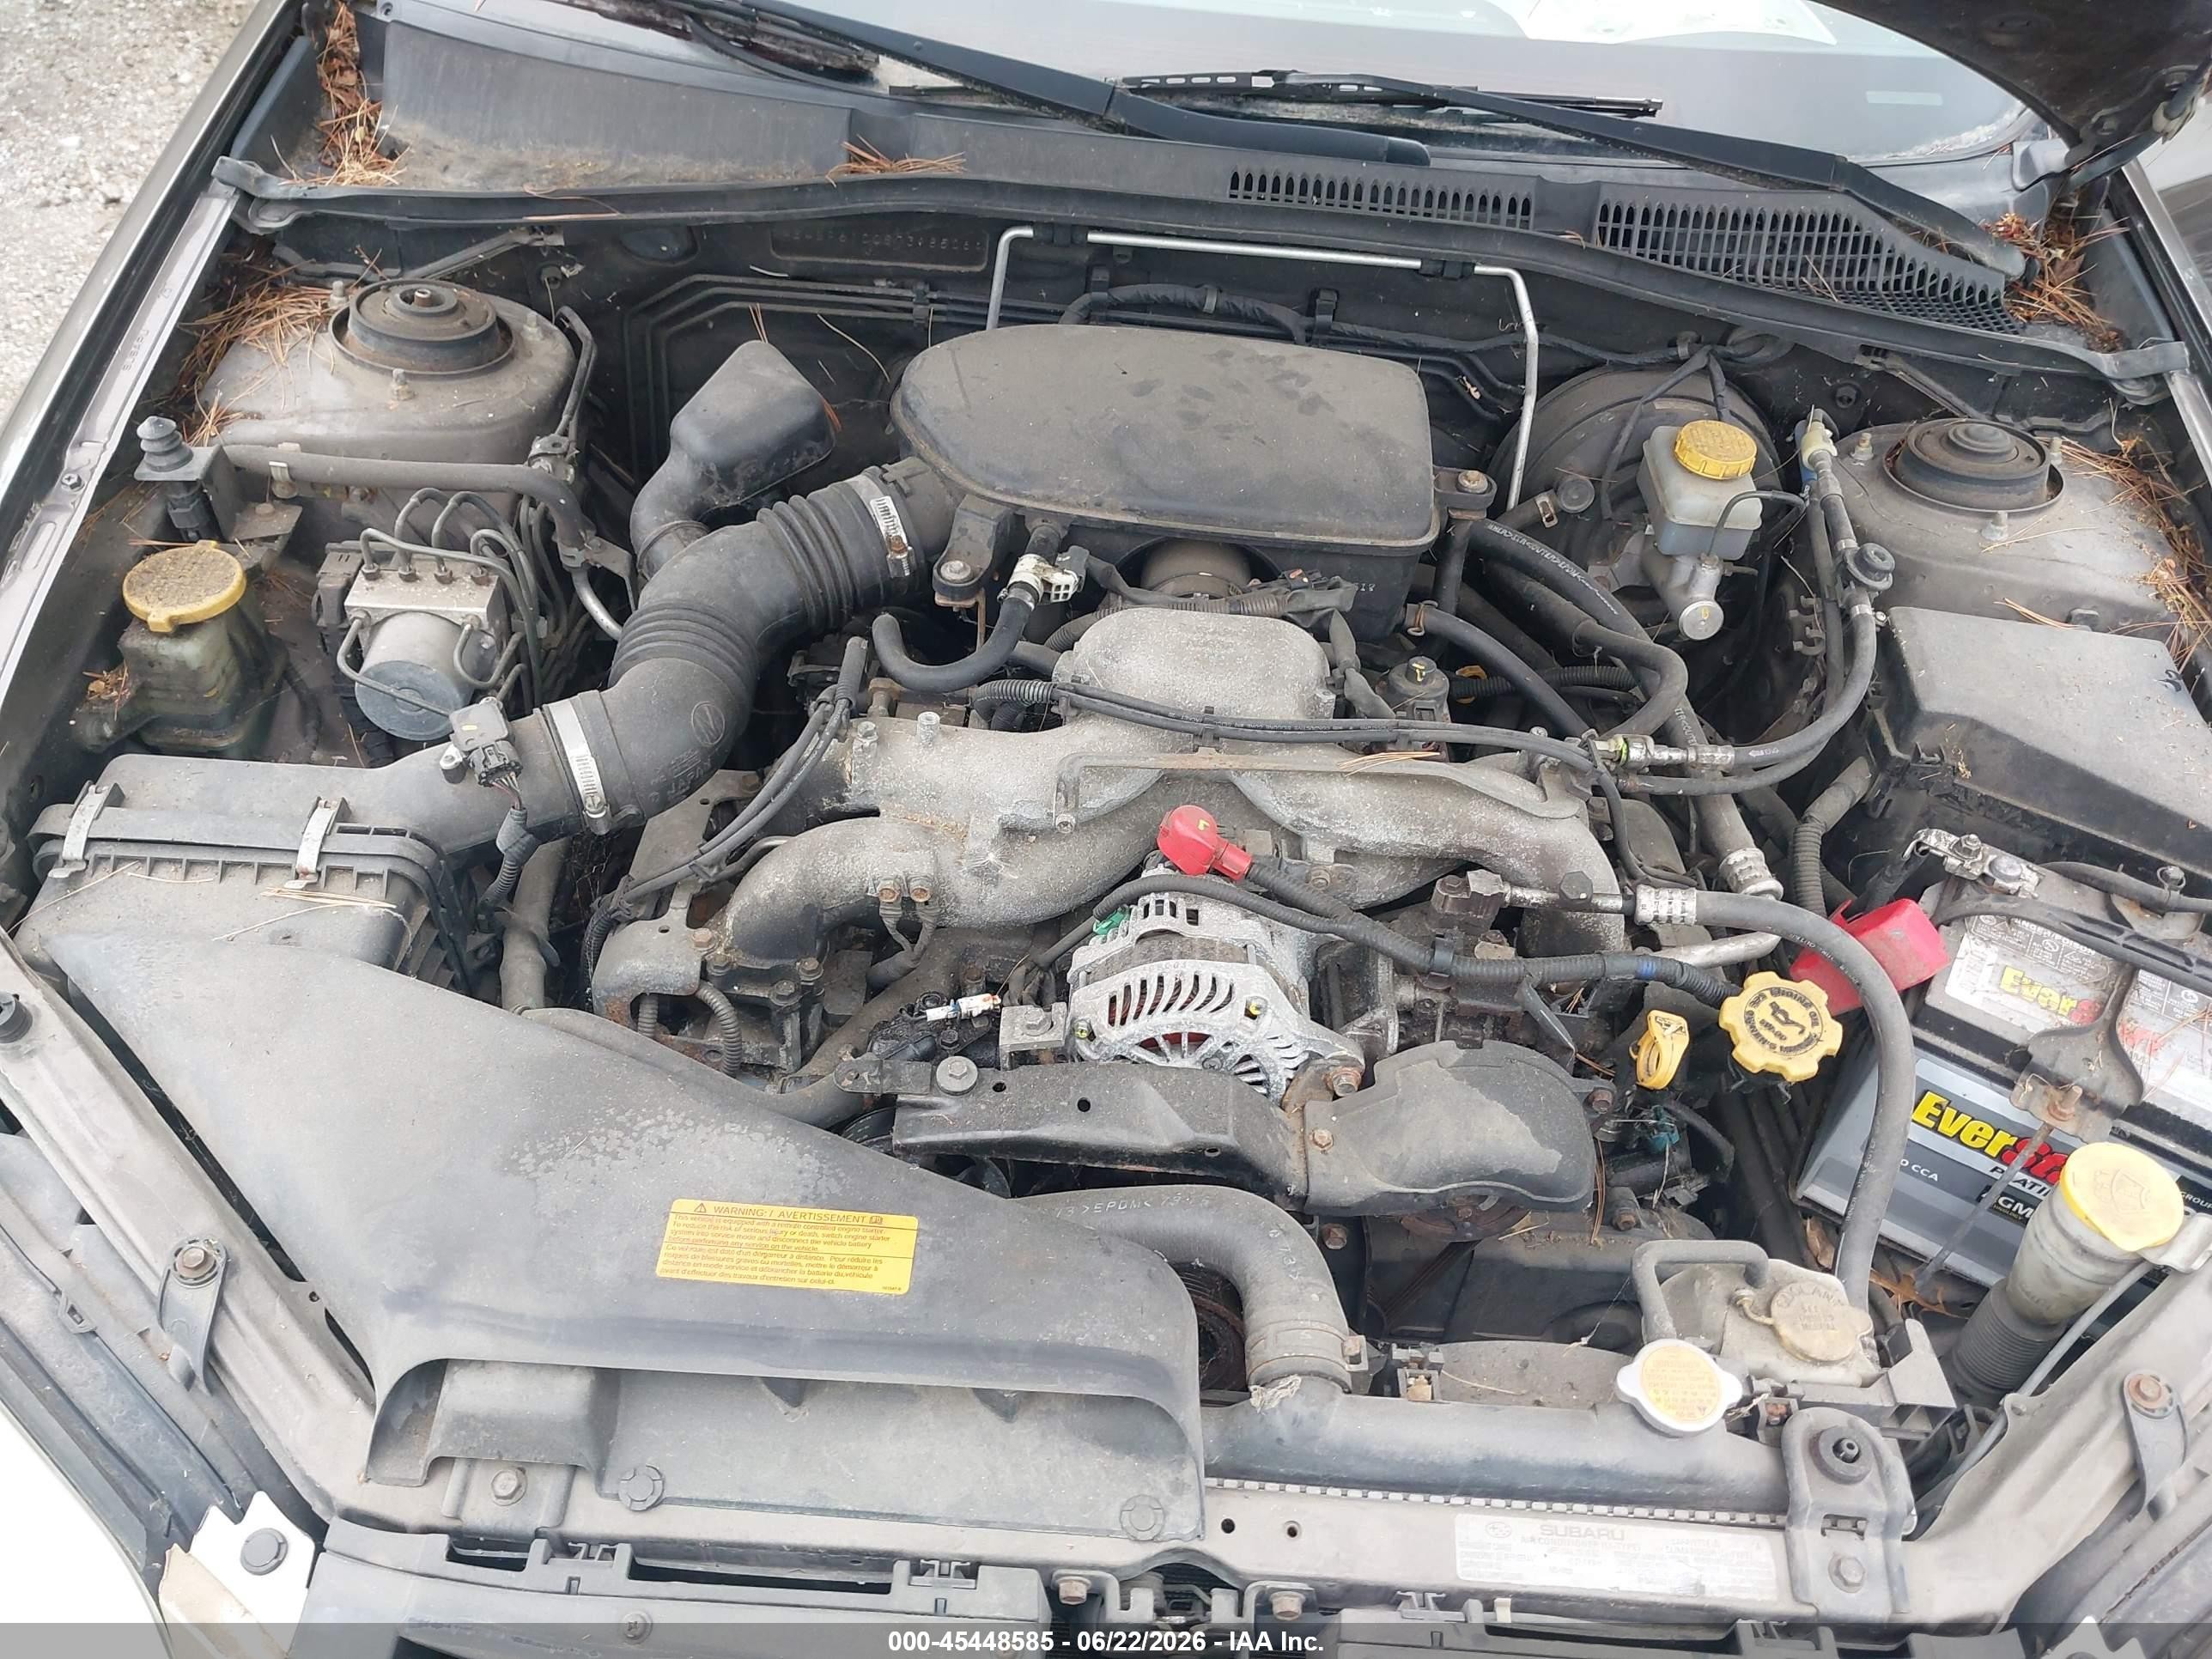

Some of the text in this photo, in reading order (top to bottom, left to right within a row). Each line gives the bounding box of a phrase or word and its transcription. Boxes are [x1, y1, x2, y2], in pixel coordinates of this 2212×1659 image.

[1911, 1164, 1938, 1182] CCA
[714, 1206, 767, 1217] WARNING:
[778, 1212, 866, 1224] AVERTISSEMENT
[1540, 1524, 1626, 1541] SUBARU
